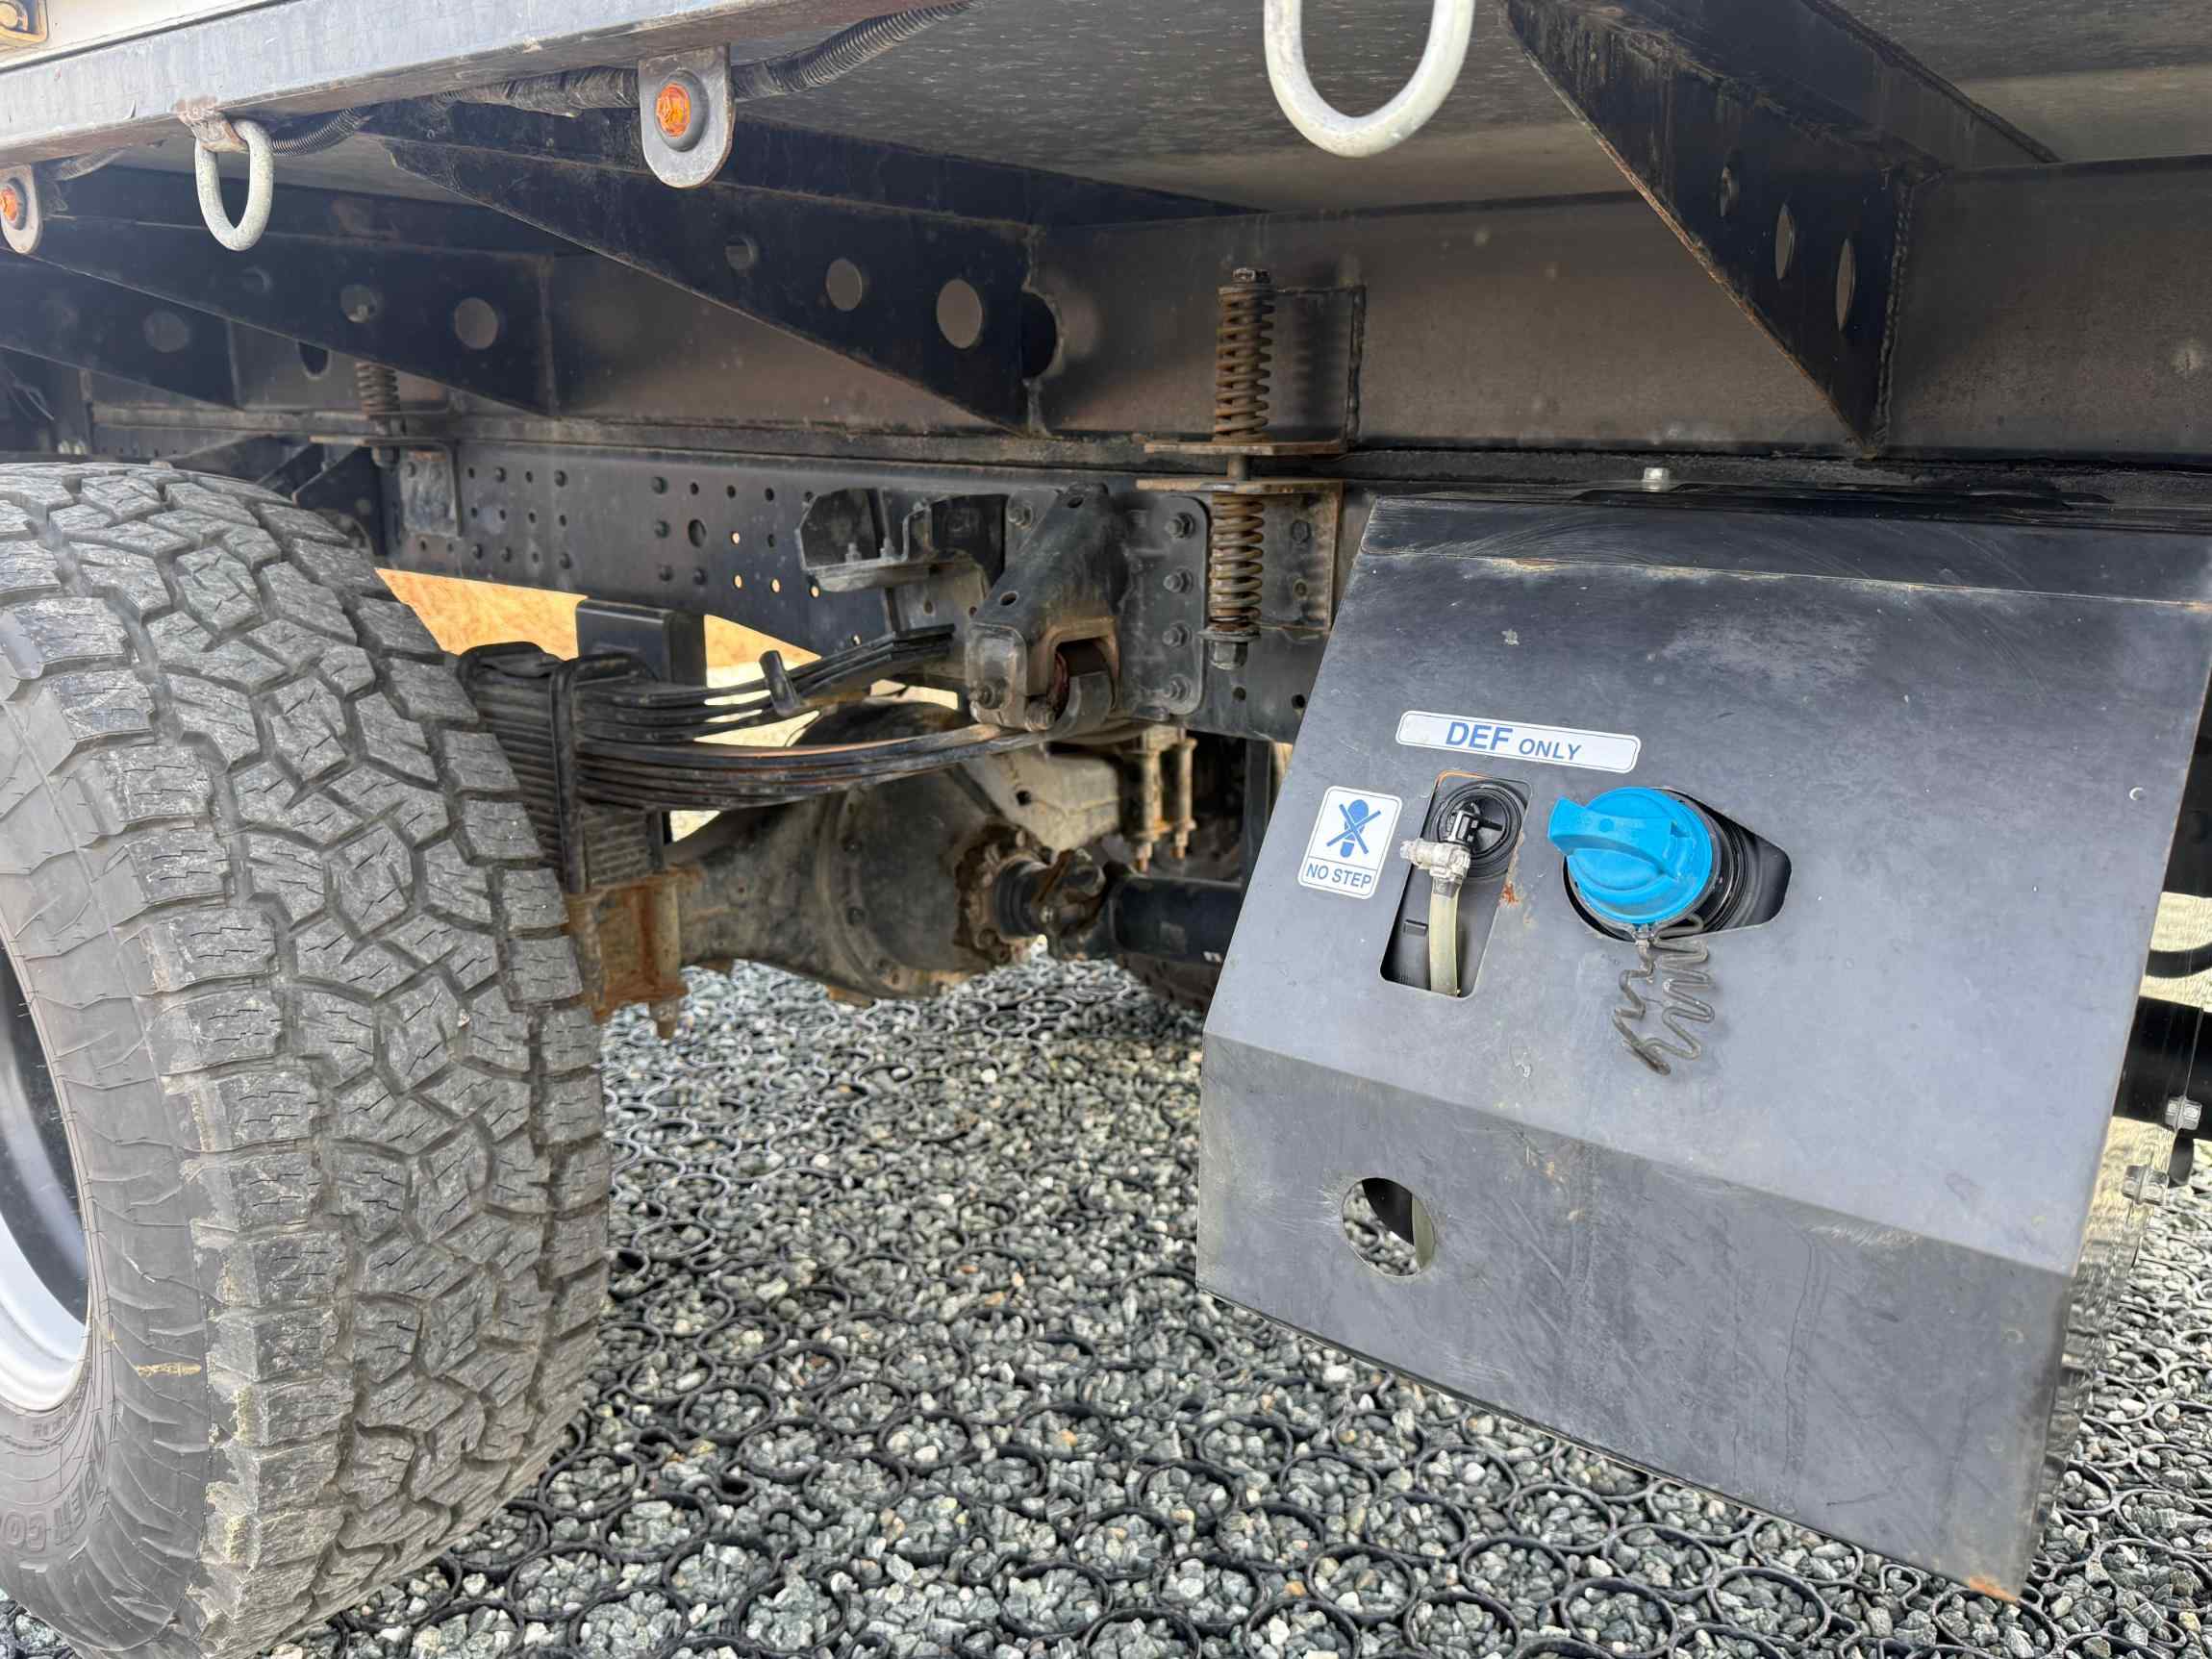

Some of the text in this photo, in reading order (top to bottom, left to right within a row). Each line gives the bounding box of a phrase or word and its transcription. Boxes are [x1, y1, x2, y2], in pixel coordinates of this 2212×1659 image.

[1445, 721, 1582, 761] DEF ONLY
[1306, 863, 1372, 889] NO STEP
